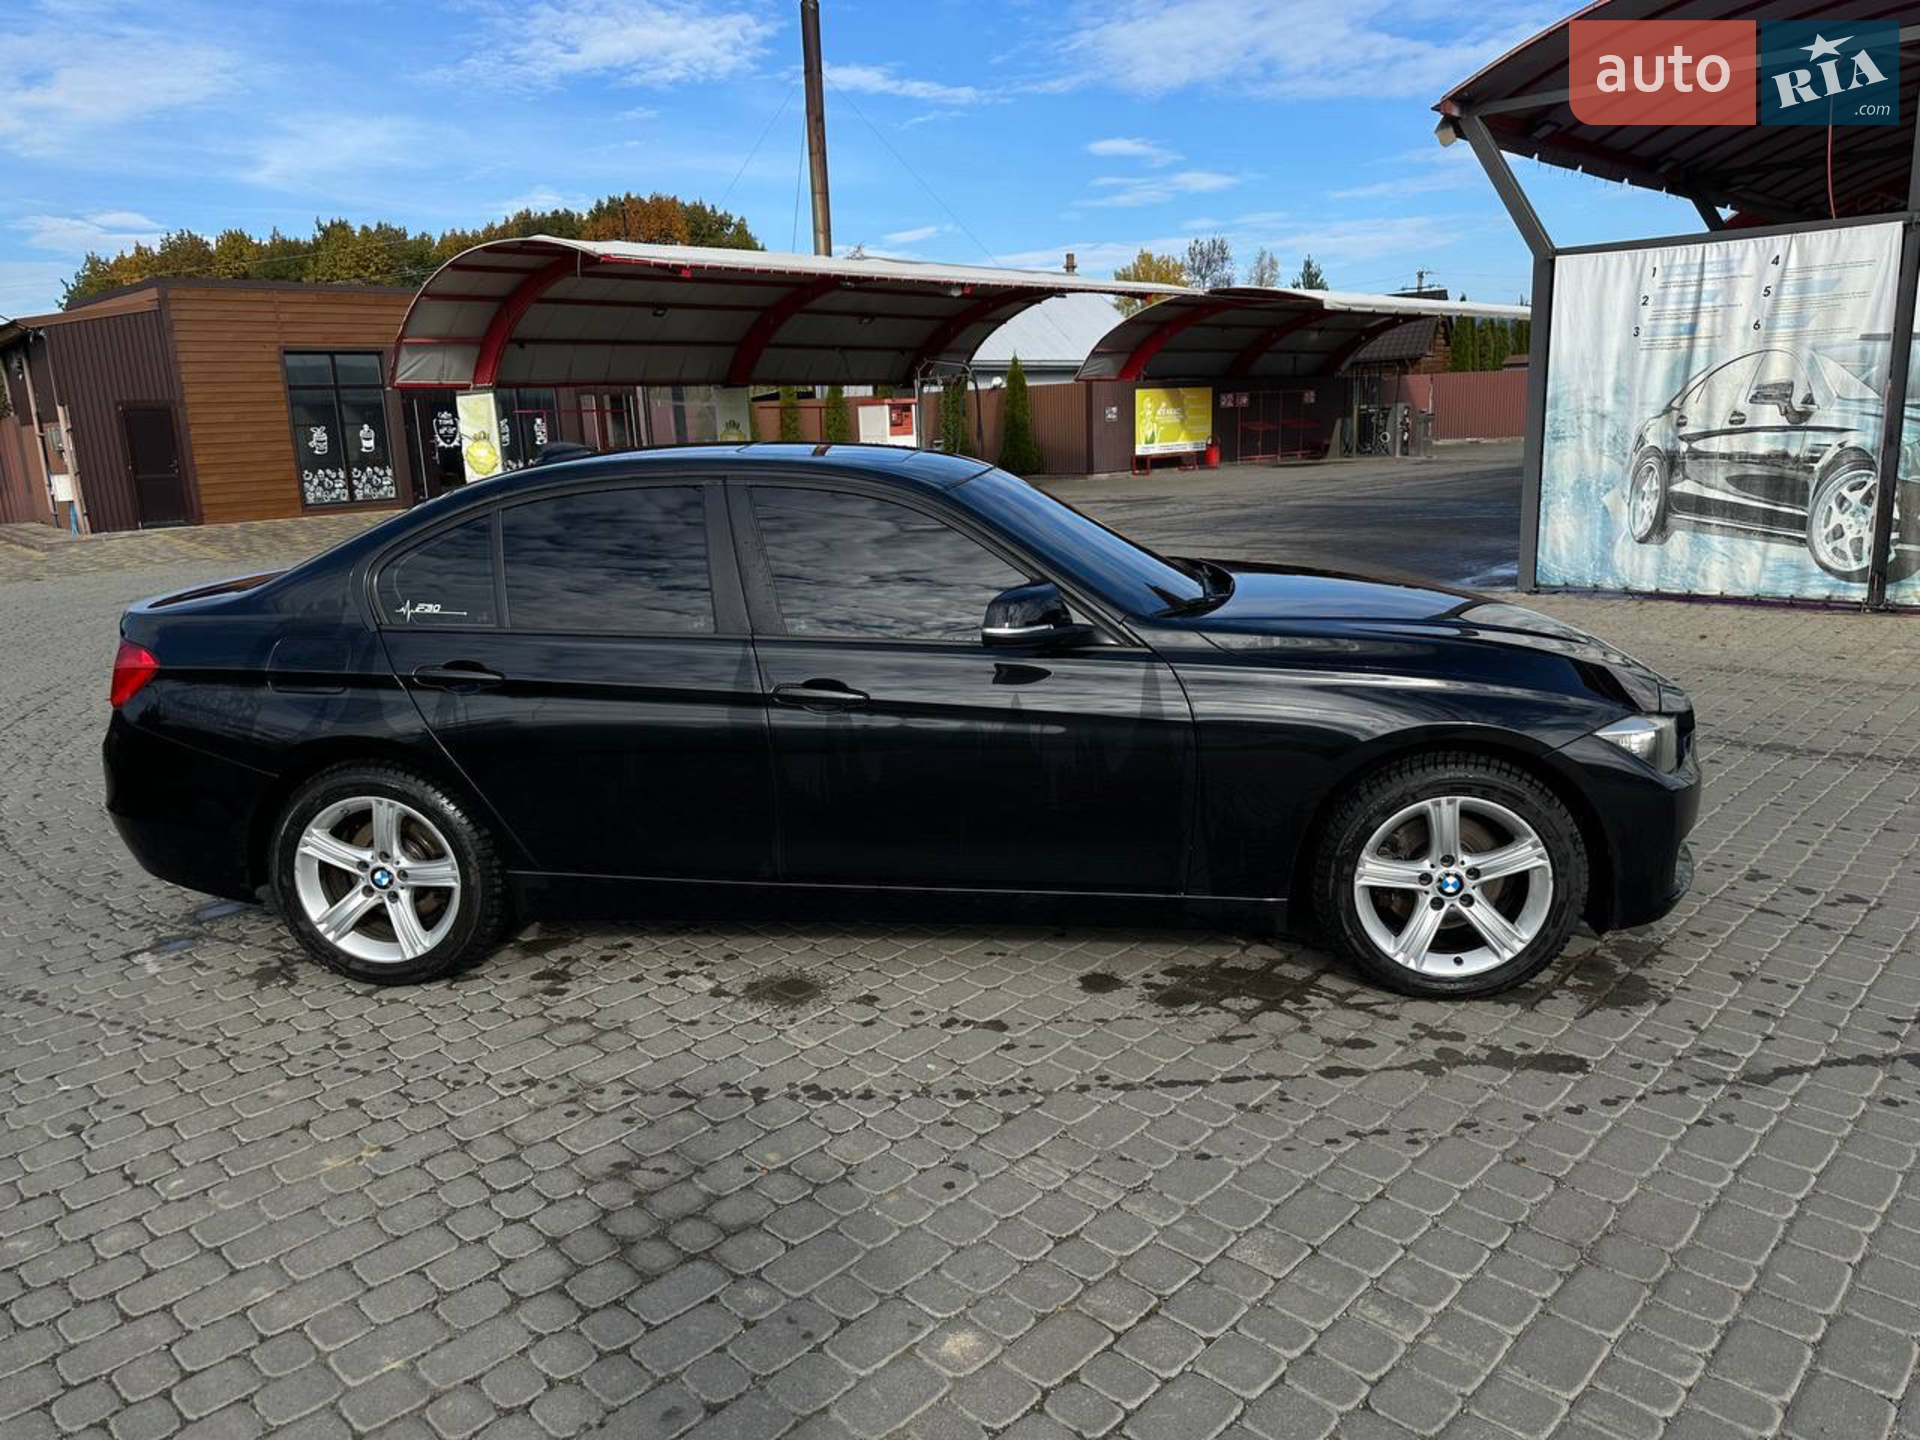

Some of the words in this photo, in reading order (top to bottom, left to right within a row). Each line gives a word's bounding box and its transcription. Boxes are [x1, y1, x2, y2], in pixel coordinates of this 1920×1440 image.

[1770, 254, 1780, 266] 4
[1651, 266, 1658, 278] 1
[1762, 285, 1772, 298] 5
[1641, 295, 1650, 306] 2
[1752, 319, 1761, 331] 6
[1633, 326, 1641, 338] 3
